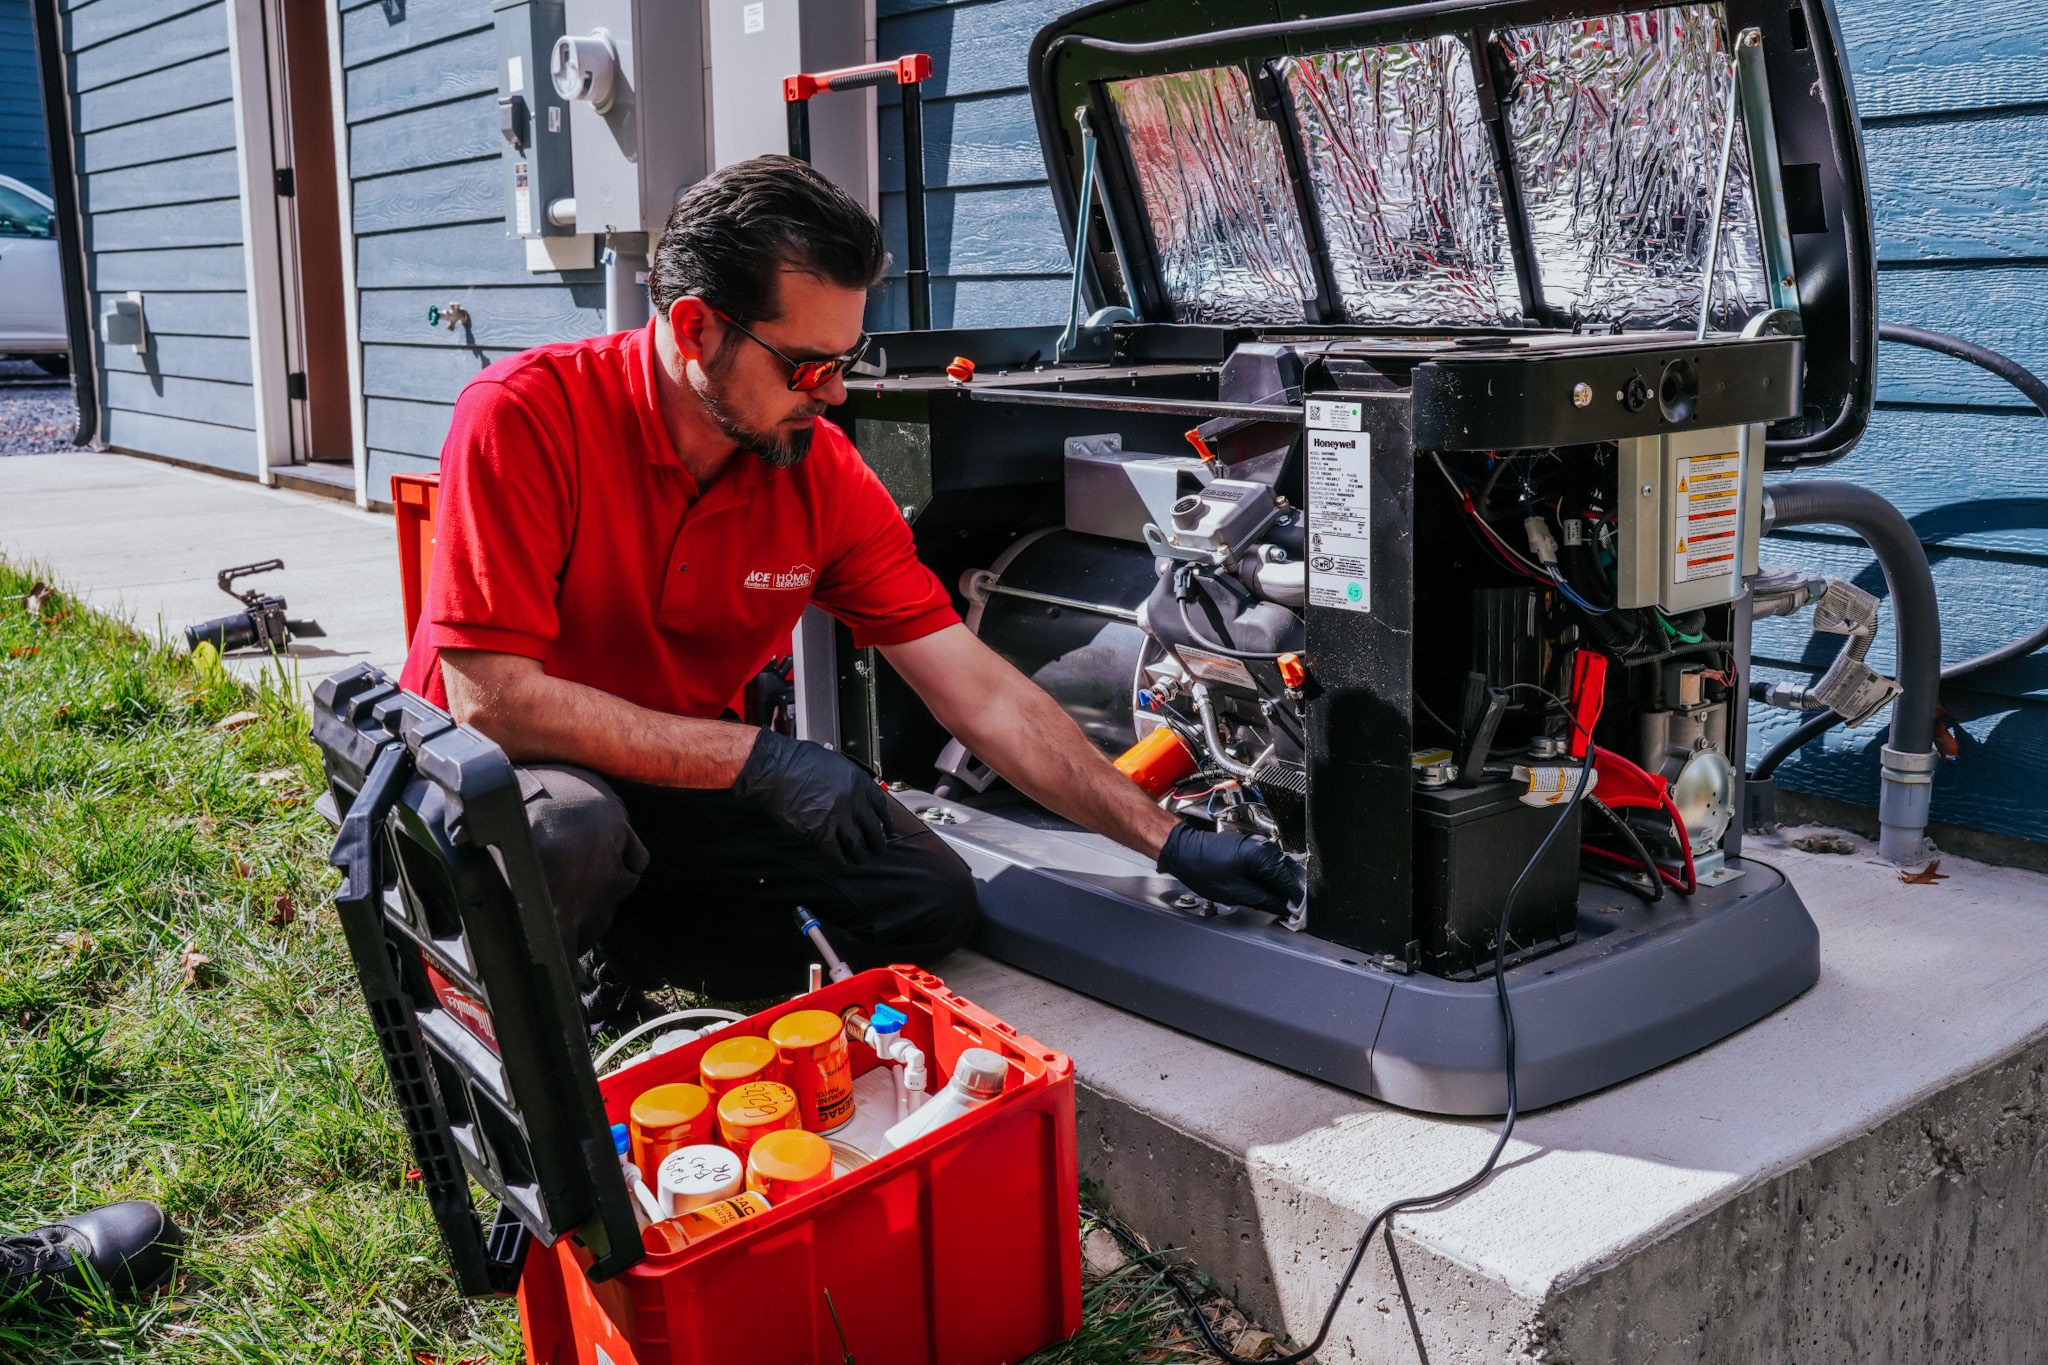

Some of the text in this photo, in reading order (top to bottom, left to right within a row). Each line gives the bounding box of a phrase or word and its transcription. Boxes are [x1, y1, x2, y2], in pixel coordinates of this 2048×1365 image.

[1314, 438, 1356, 450] Honeywell
[744, 570, 810, 582] ACE HOME
[776, 580, 810, 588] SERVICES
[445, 994, 496, 1041] Milwaukee
[815, 1085, 839, 1099] PARTS
[817, 1088, 846, 1106] GENUINE
